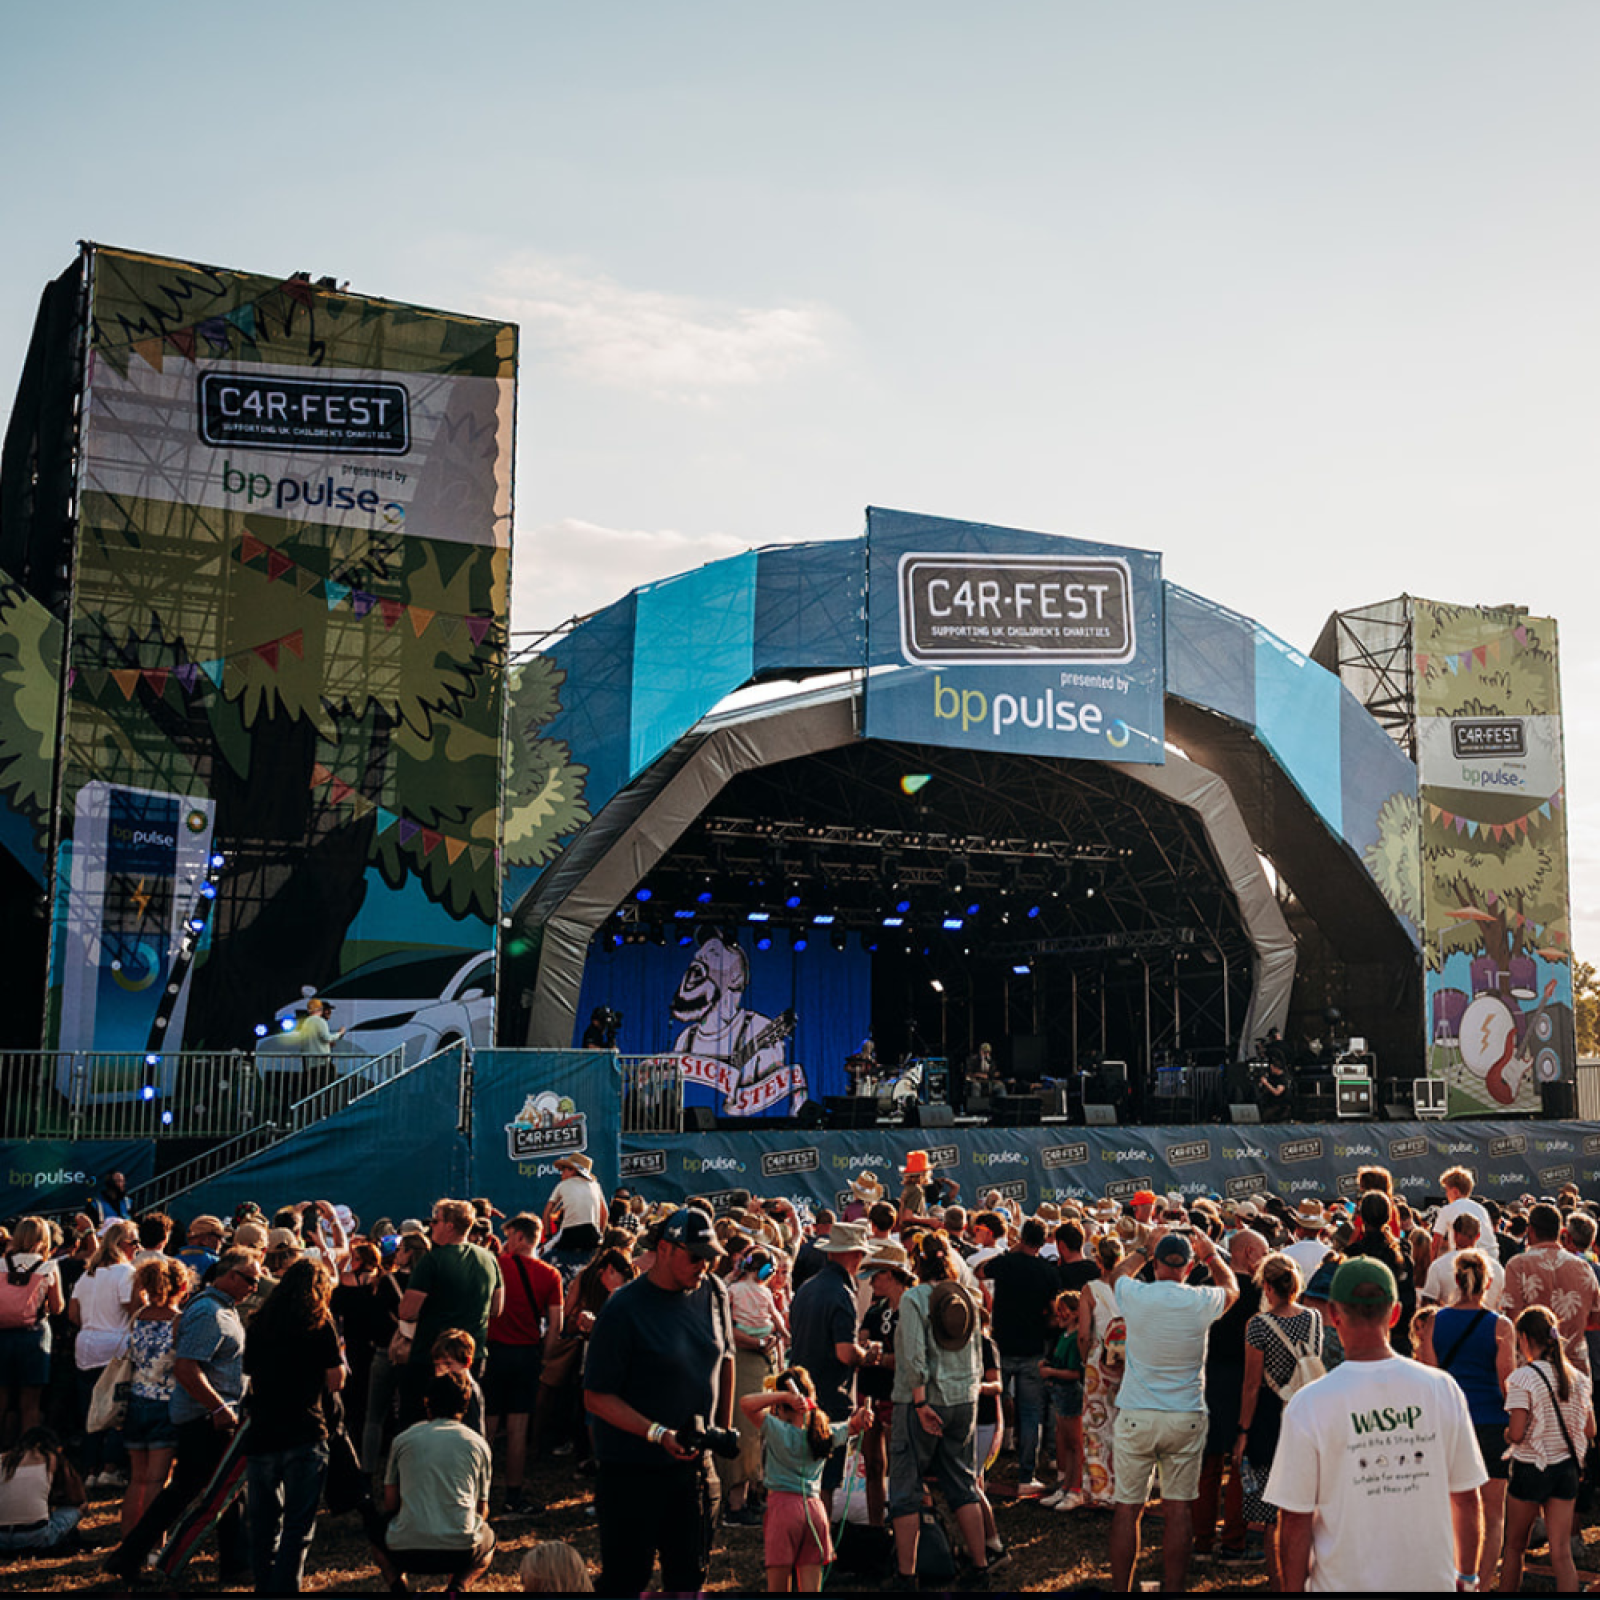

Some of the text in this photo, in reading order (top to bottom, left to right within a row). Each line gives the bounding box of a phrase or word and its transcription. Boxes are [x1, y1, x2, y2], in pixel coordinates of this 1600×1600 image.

[341, 464, 408, 484] presented by
[931, 625, 990, 637] SUPPORTING
[991, 626, 1005, 637] UK
[1063, 626, 1111, 638] CHARITIES
[1060, 672, 1130, 694] presented by
[737, 1068, 803, 1110] STEVE
